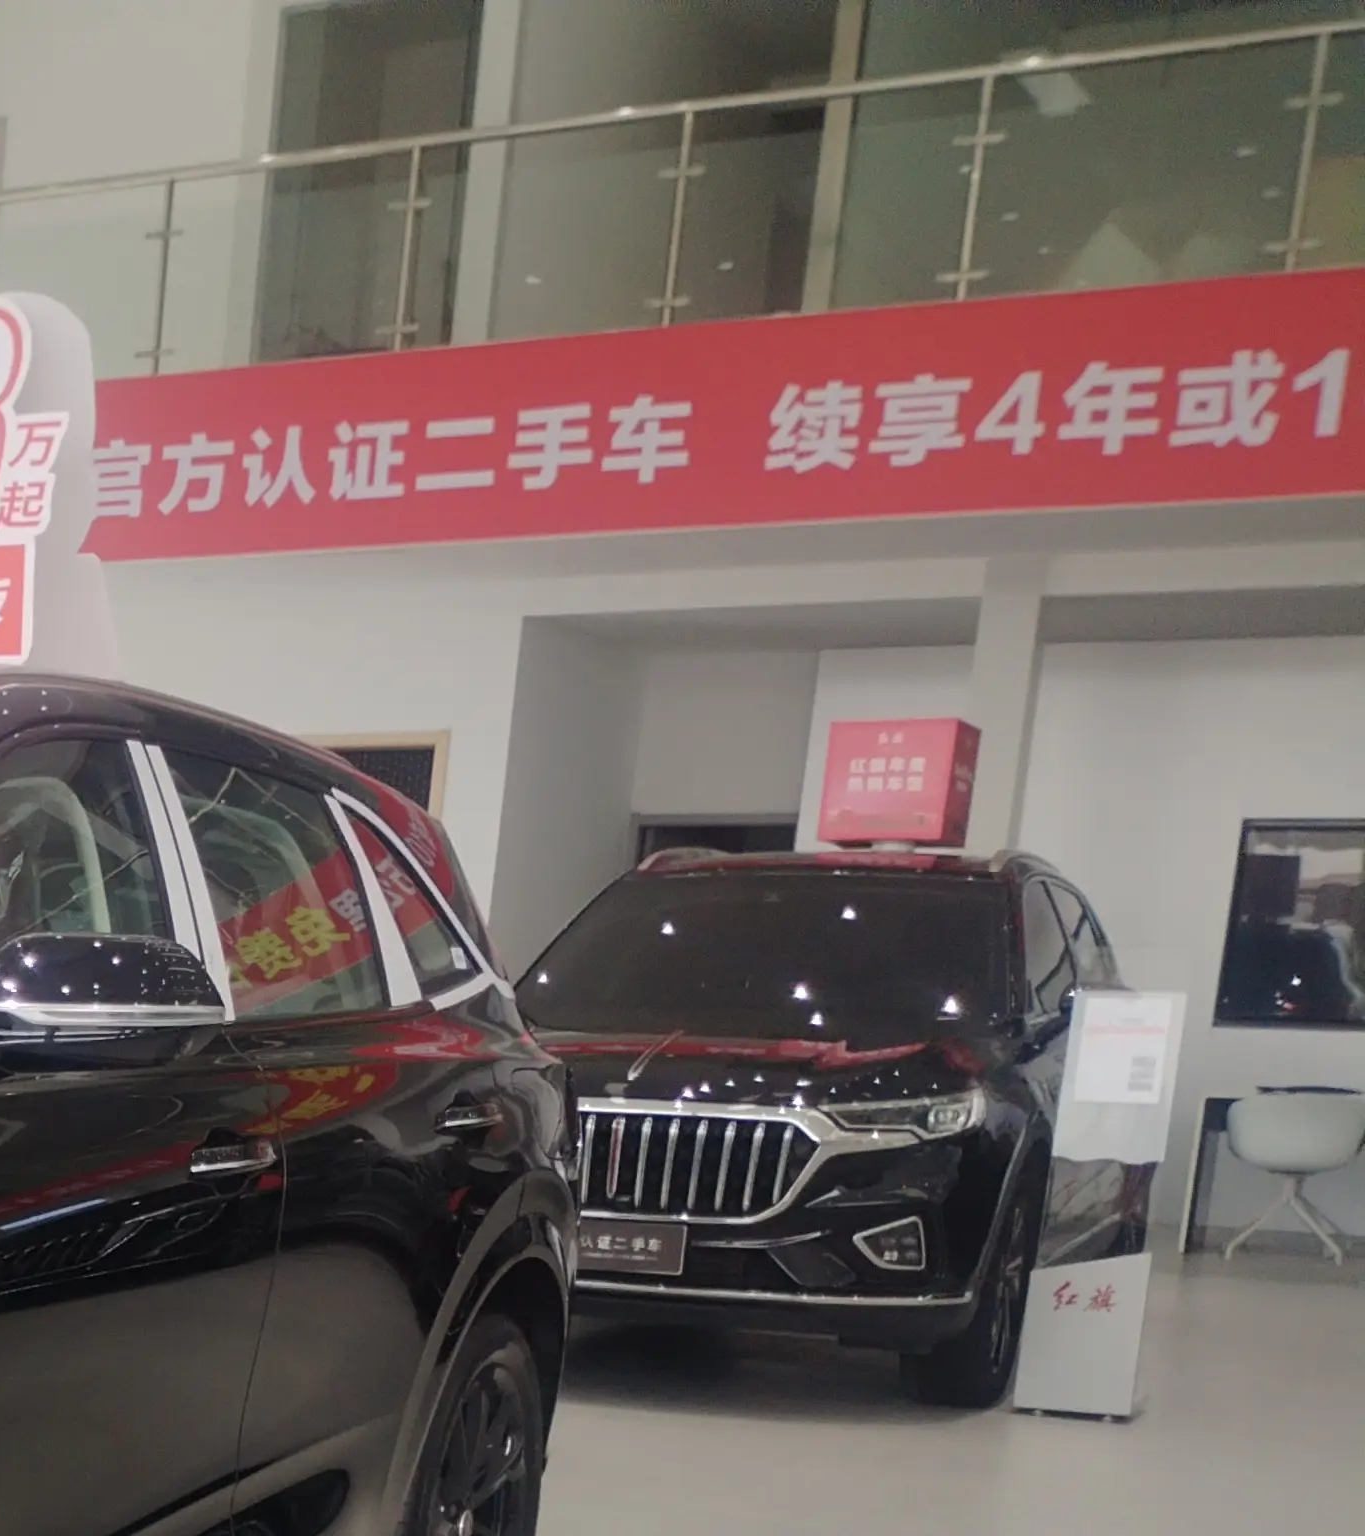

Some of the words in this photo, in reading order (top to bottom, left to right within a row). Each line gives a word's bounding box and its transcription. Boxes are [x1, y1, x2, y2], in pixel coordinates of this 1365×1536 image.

[92, 394, 693, 519] 官方认证二手车
[764, 346, 1352, 475] 续享4年或1
